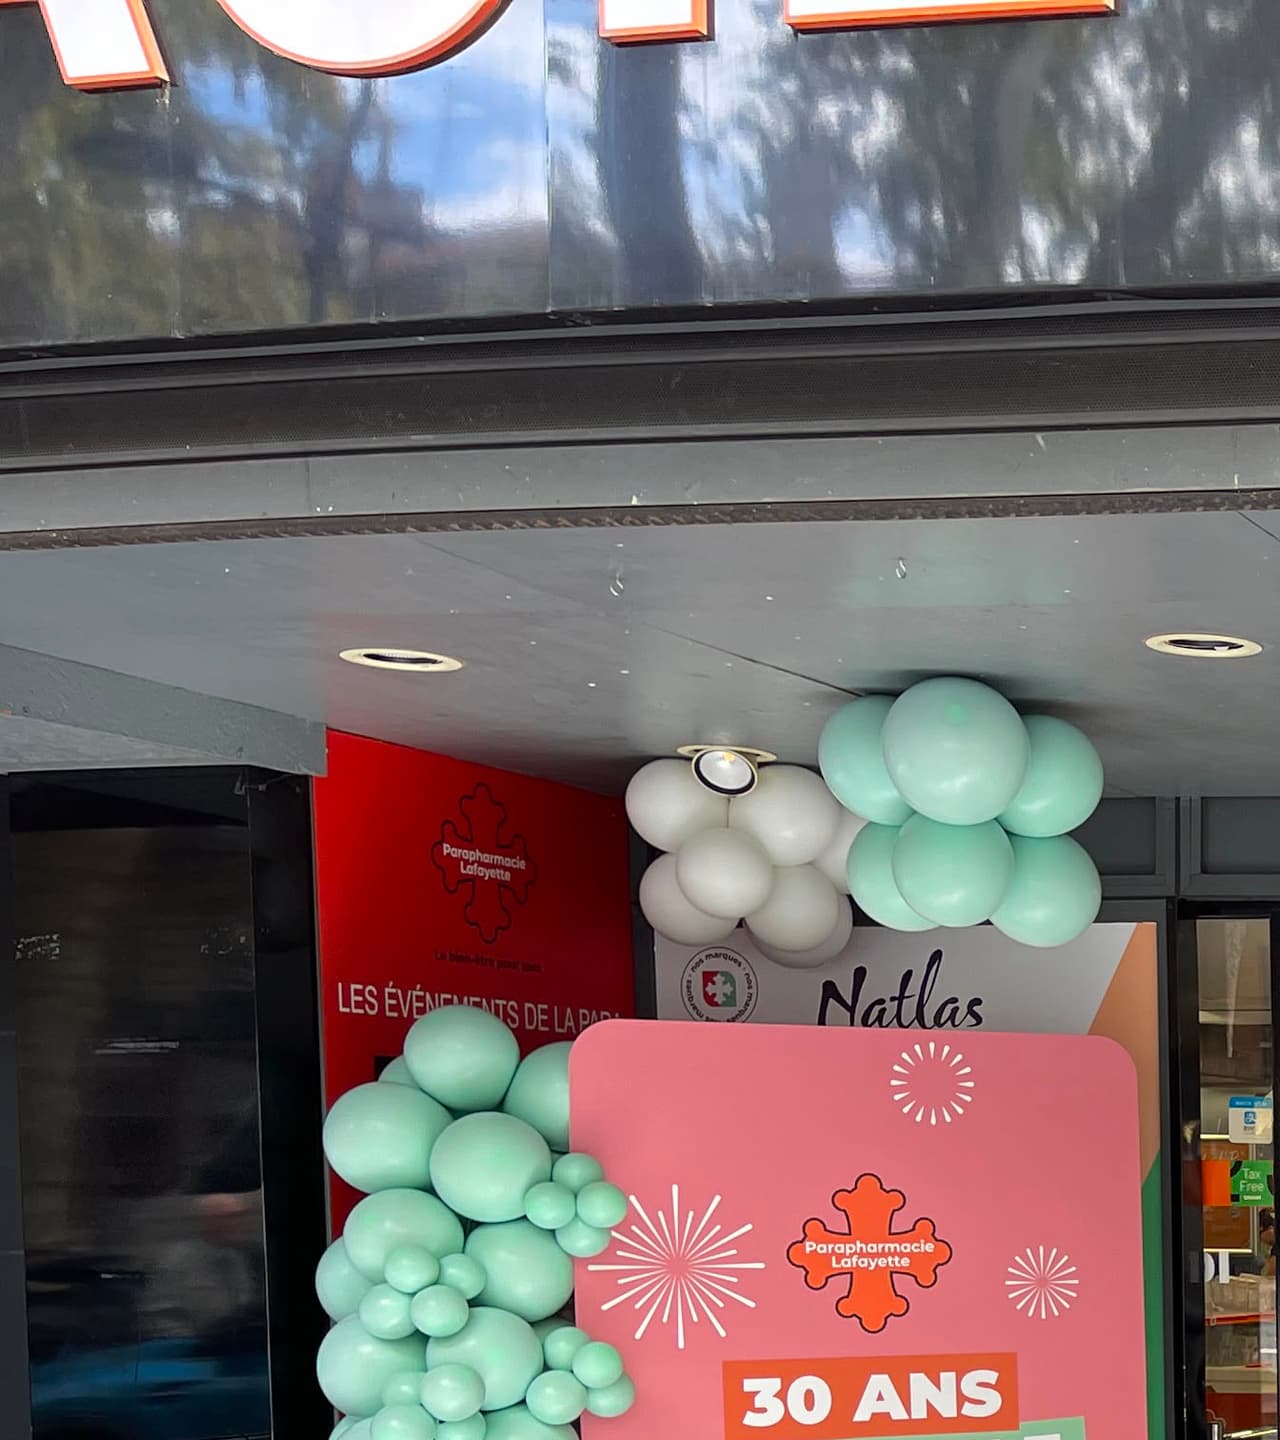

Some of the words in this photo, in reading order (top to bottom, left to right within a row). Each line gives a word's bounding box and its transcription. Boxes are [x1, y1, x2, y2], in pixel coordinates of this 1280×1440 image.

[443, 842, 526, 870] Parapharmacie
[460, 861, 511, 881] Lafayette
[817, 949, 984, 1030] Natlas
[337, 981, 379, 1015] LES
[384, 980, 518, 1029] ÉVÉNTS
[525, 1003, 550, 1032] DE
[554, 1005, 576, 1035] LA
[1242, 1168, 1261, 1180] Tax
[1239, 1181, 1264, 1192] Free
[805, 1240, 935, 1257] Parapharmacie
[831, 1254, 911, 1270] Lafayette
[742, 1375, 832, 1428] 30
[852, 1369, 1002, 1424] ANS
